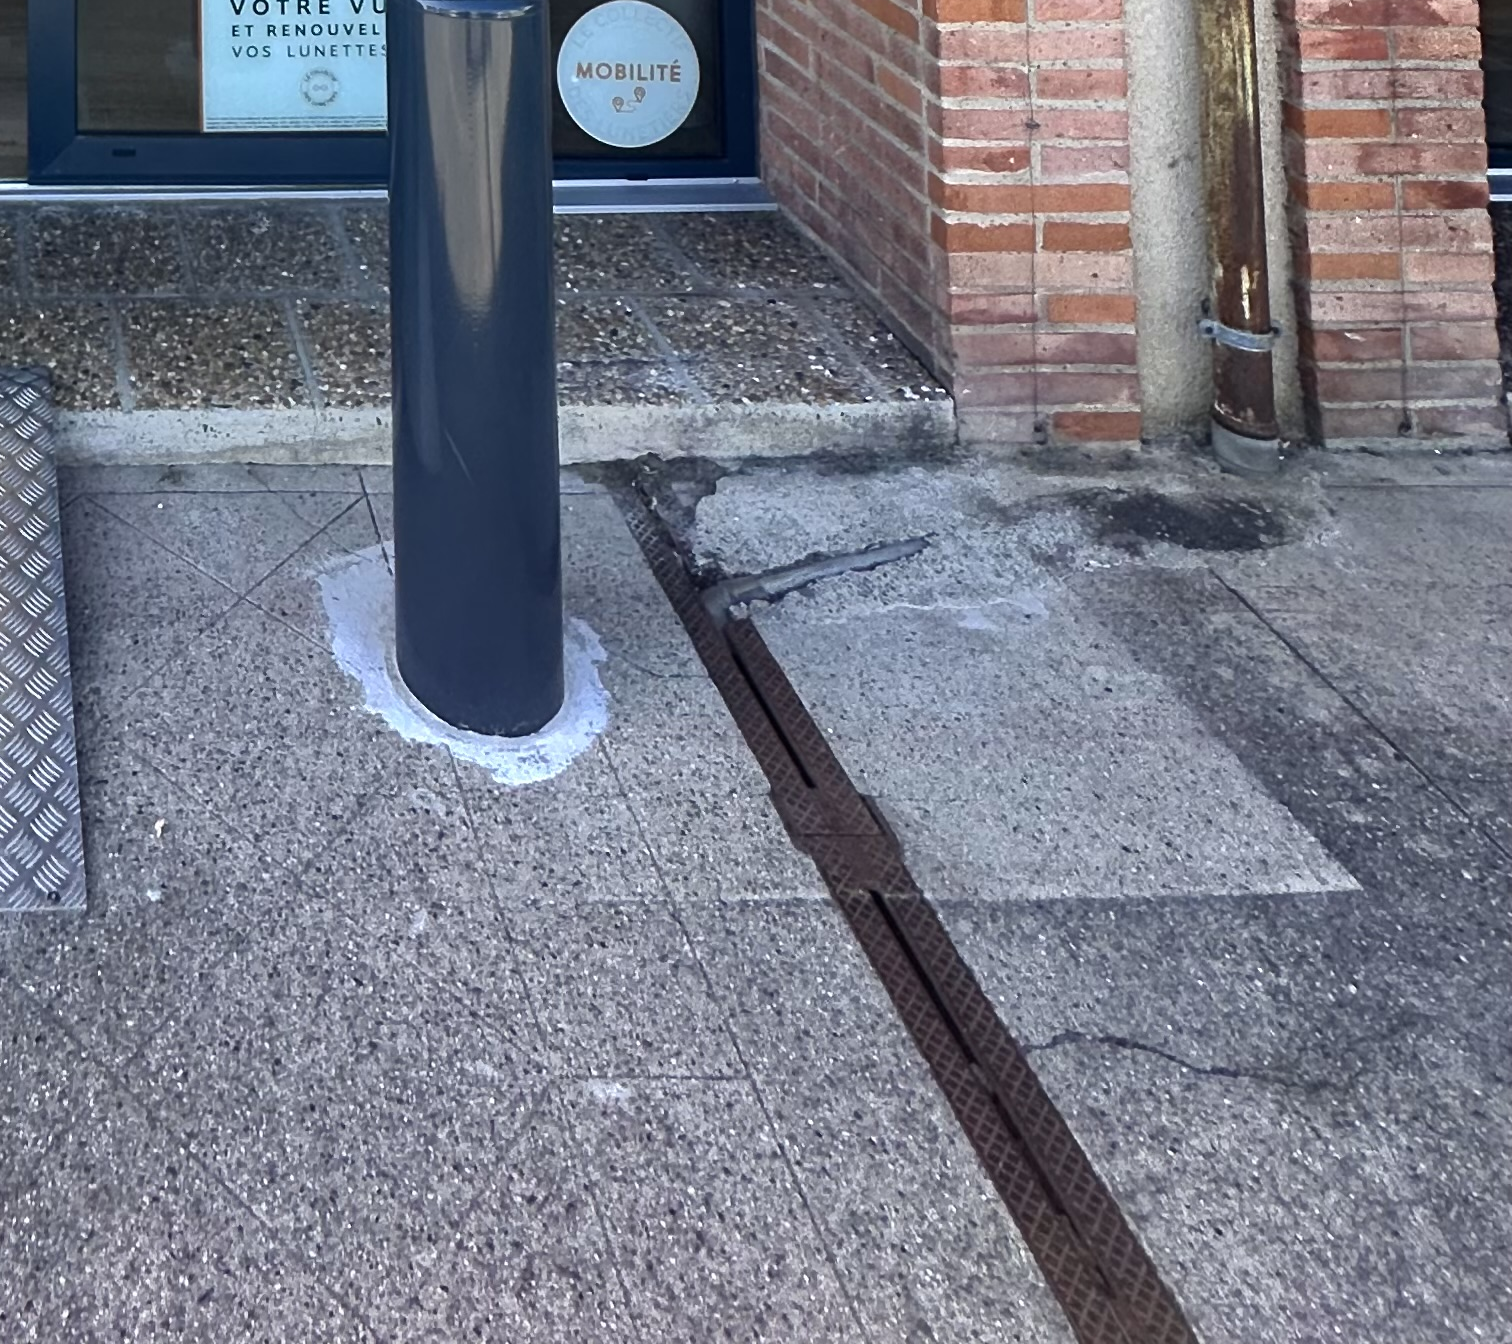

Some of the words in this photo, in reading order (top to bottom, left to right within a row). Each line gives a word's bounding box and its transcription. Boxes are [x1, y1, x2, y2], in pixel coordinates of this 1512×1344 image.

[231, 23, 254, 38] ET
[267, 22, 381, 37] RENOUVEL
[232, 44, 272, 59] VOS
[287, 43, 387, 58] LUNETTES
[575, 58, 682, 83] MOBILITÉ
